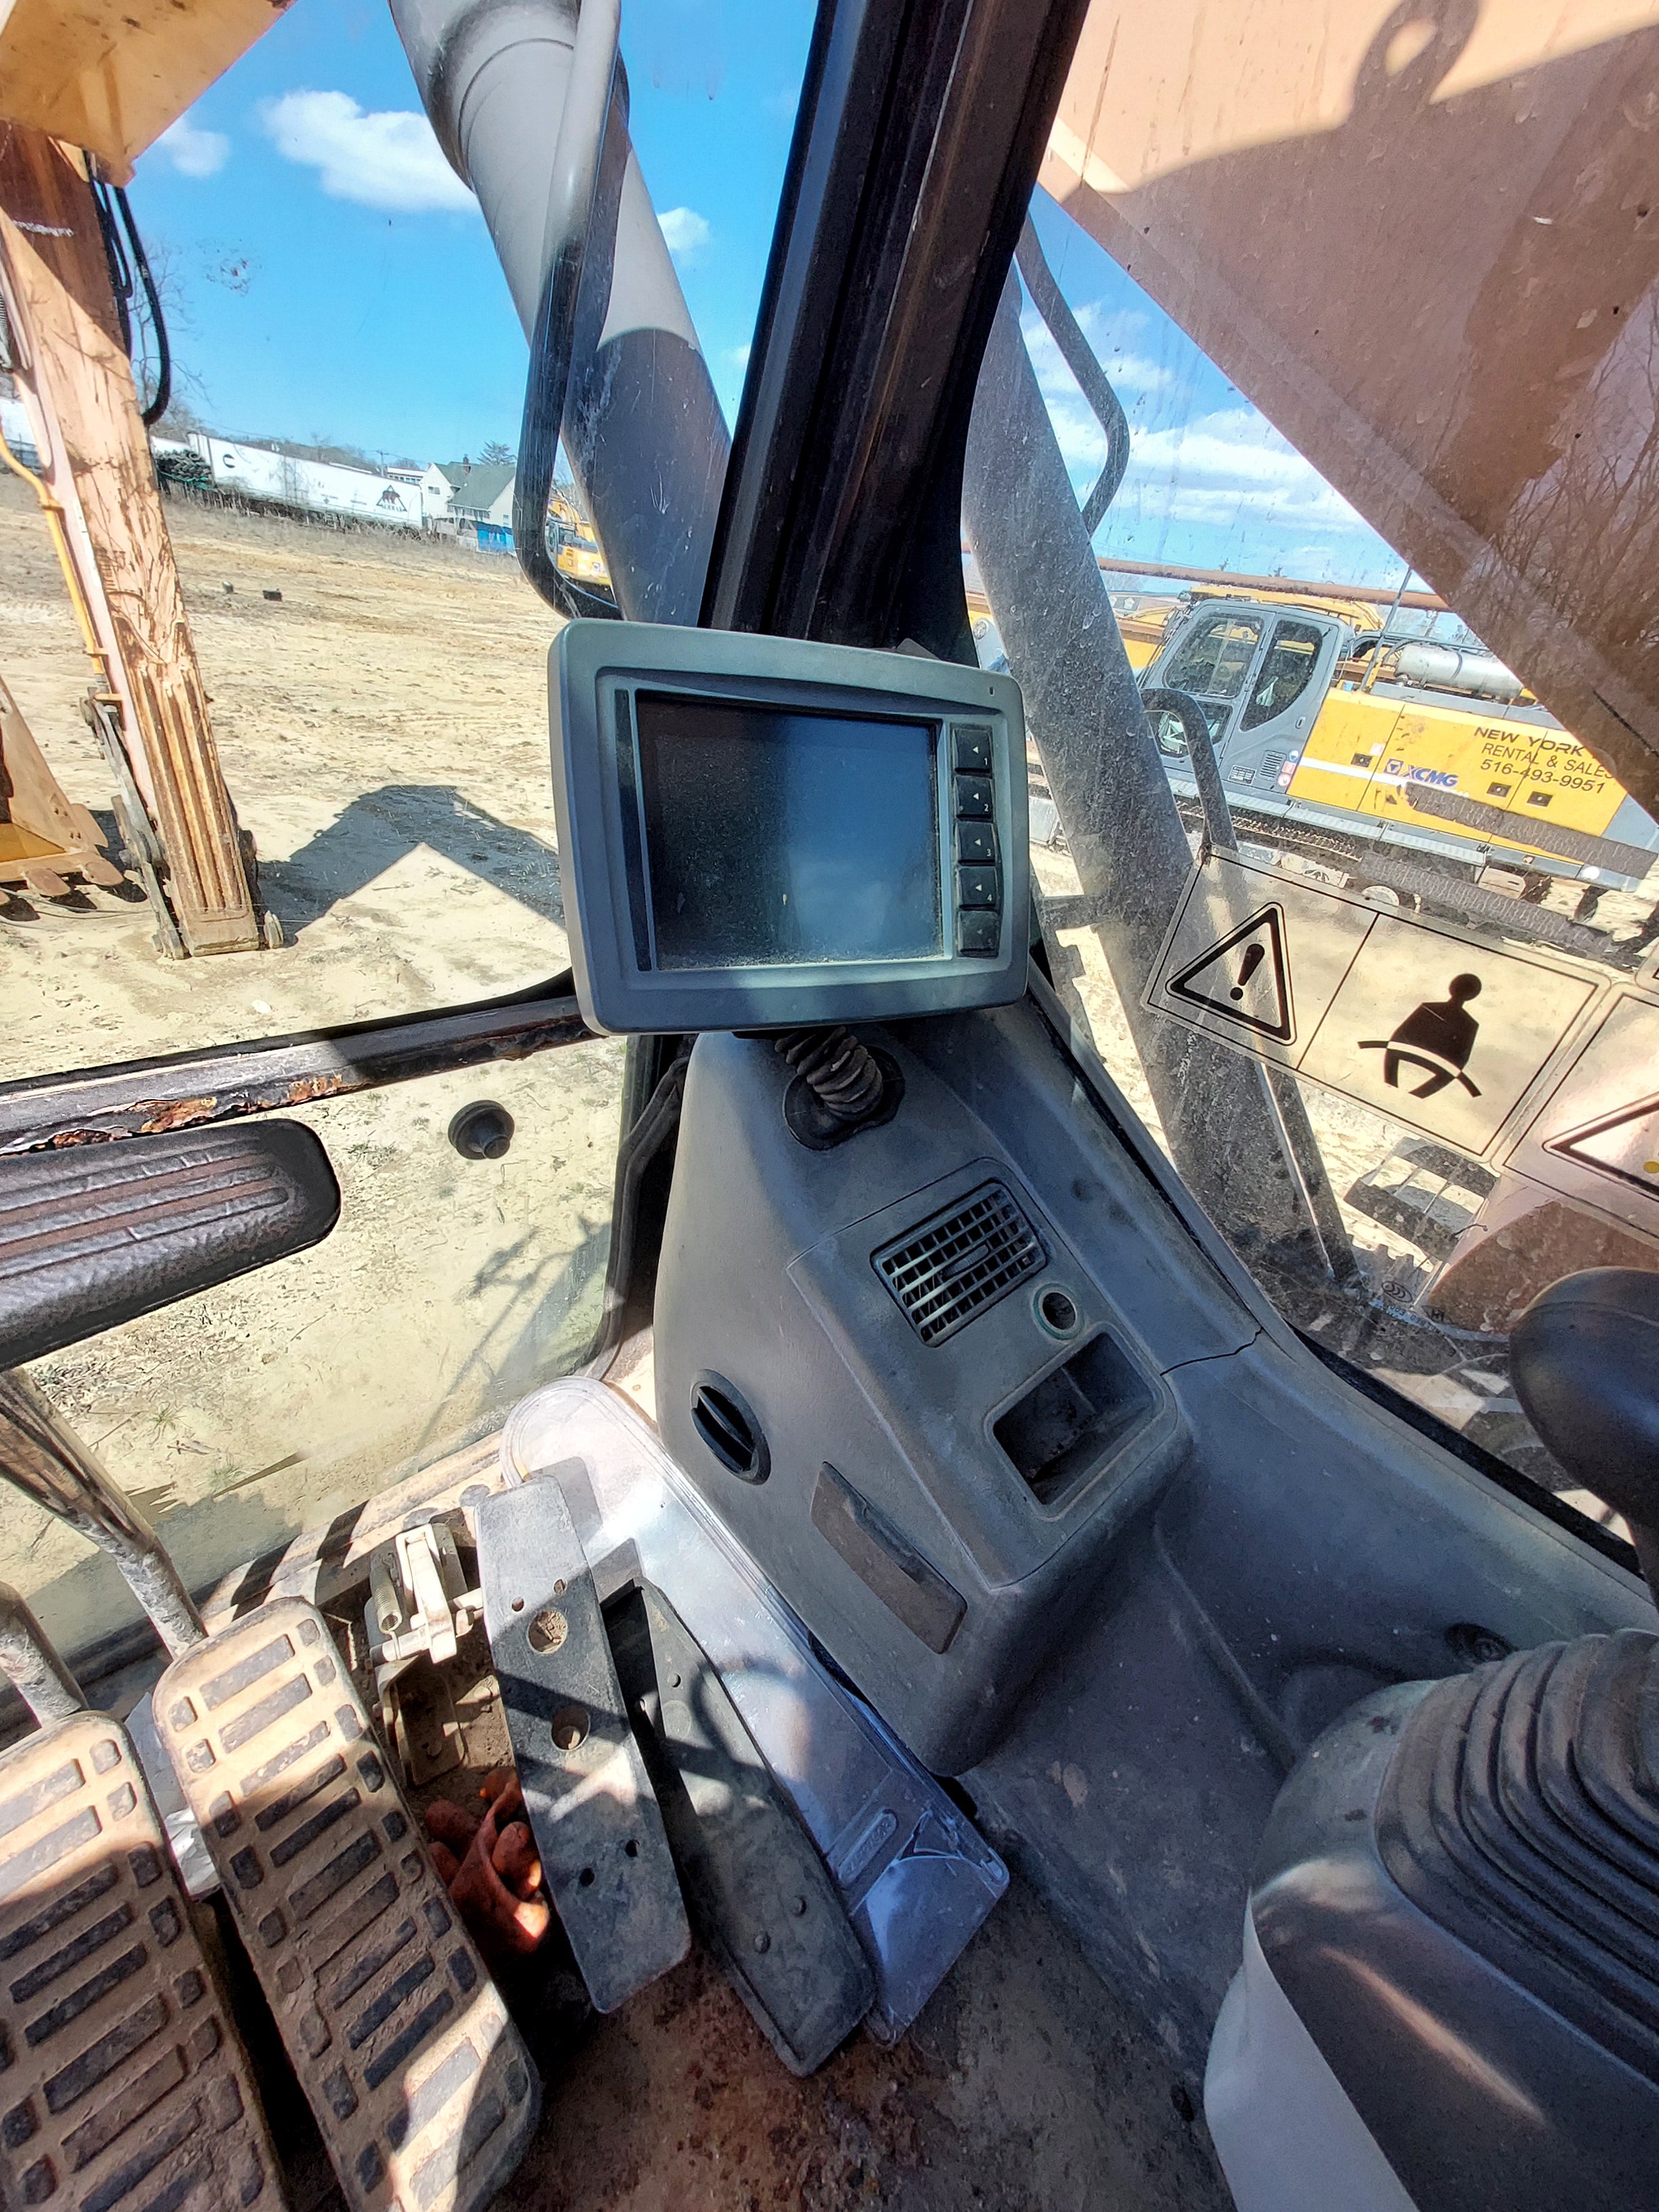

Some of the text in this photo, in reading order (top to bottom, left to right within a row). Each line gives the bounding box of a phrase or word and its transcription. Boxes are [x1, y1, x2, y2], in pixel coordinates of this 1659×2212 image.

[1474, 726, 1585, 756] NEW YORK
[984, 758, 988, 766] 1
[1481, 743, 1540, 764] RENTAL
[1547, 755, 1558, 768] &
[1402, 765, 1458, 786] XCMG
[1480, 758, 1605, 794] 516-493-9951
[984, 804, 989, 812] 2
[986, 848, 991, 857] 3
[987, 894, 993, 902] 4
